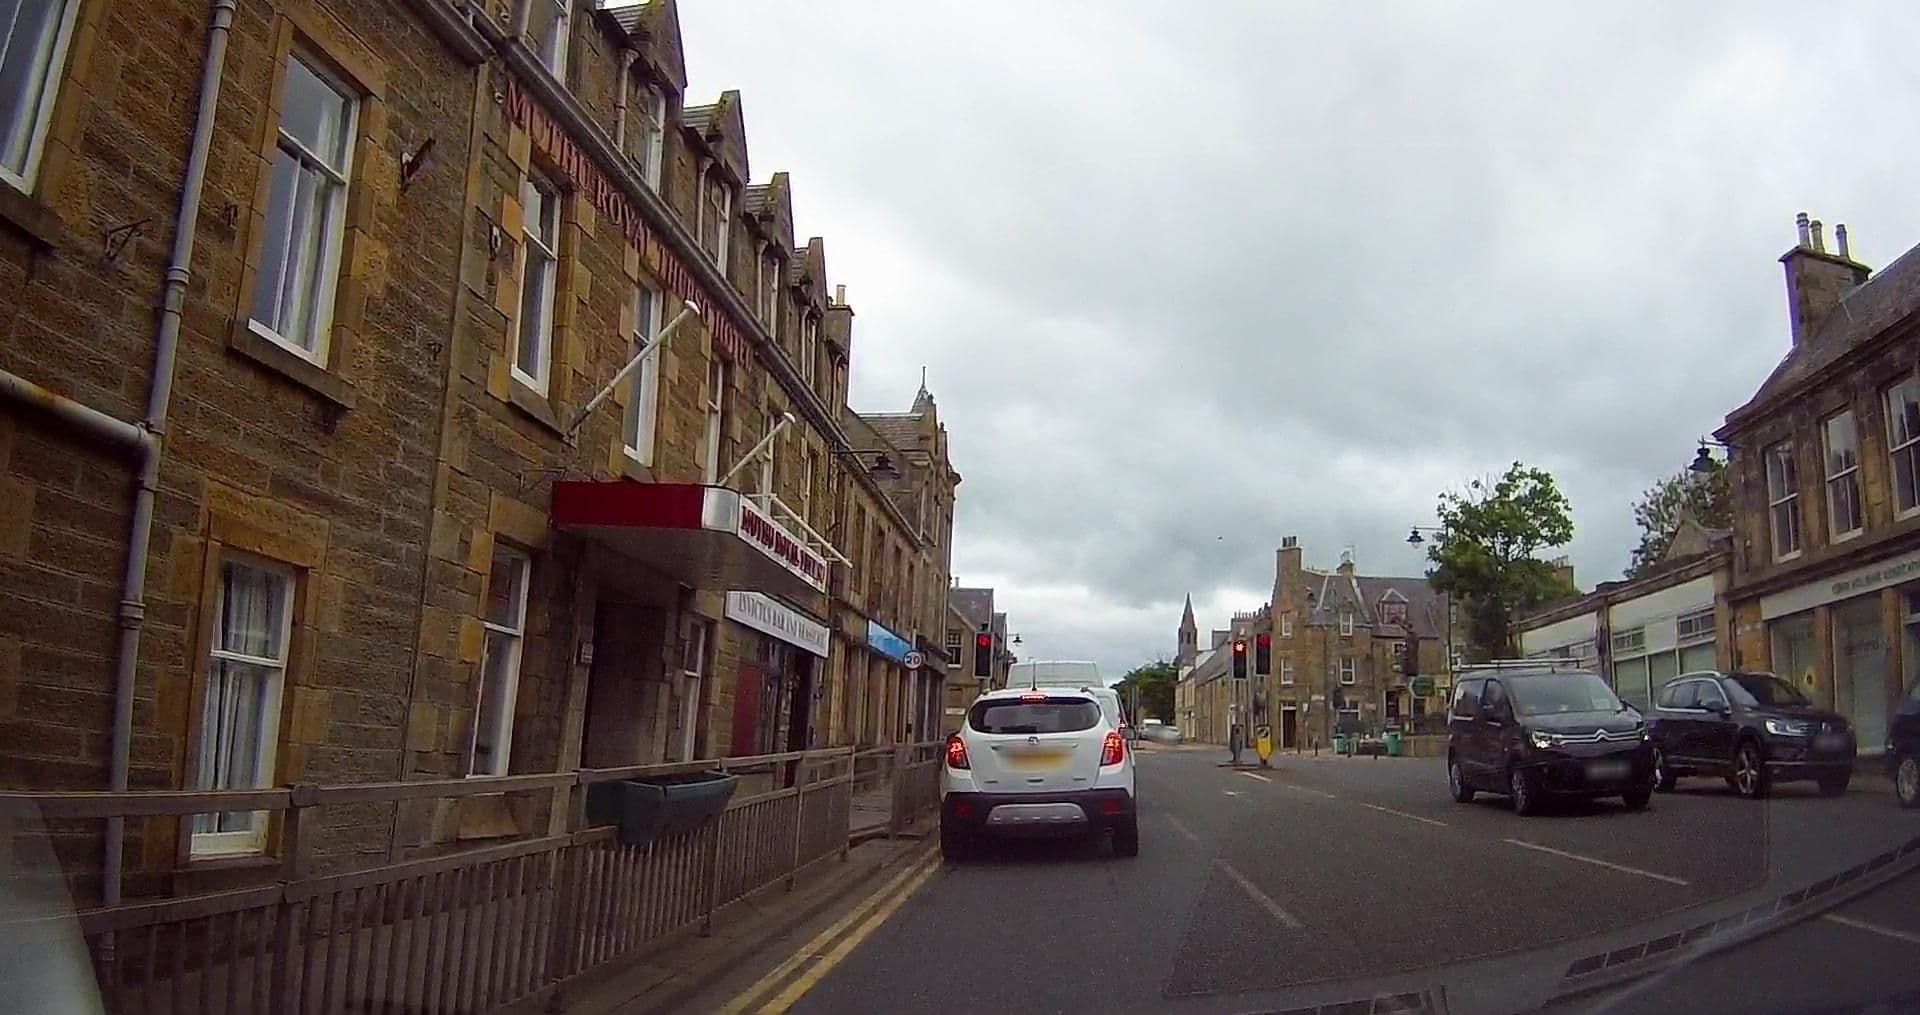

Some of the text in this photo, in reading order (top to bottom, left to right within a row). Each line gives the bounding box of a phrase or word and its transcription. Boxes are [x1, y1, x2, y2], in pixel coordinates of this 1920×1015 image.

[507, 79, 752, 374] MUTHU ROYAL THURSO HOTEL
[906, 655, 920, 665] 20
